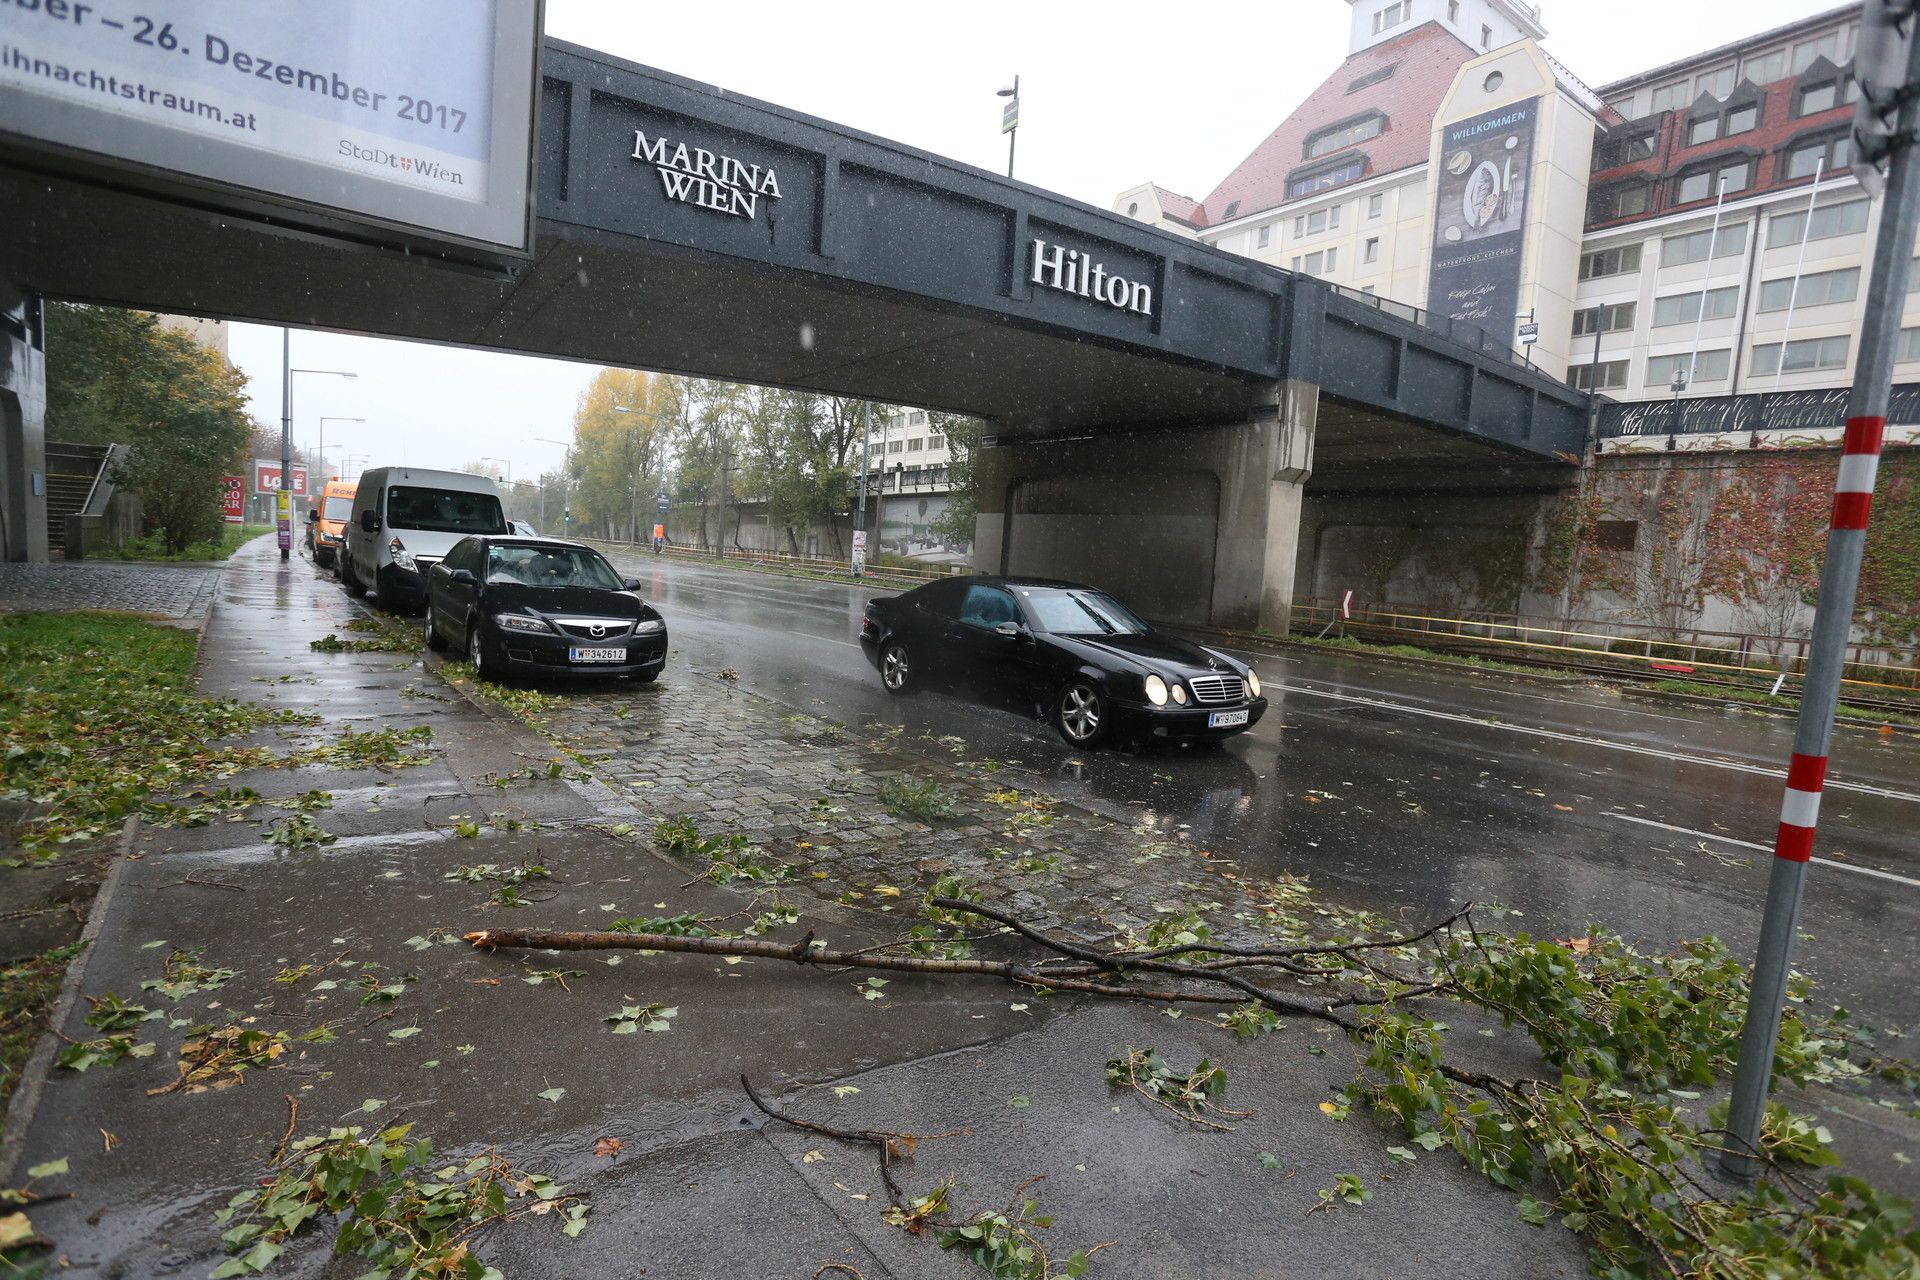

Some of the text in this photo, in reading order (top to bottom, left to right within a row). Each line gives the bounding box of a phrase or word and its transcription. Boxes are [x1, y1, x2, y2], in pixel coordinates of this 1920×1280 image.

[205, 34, 386, 111] Dezember
[396, 94, 467, 133] 2017
[1453, 110, 1527, 141] WILLKOMMEN
[414, 158, 463, 185] Wien
[631, 130, 782, 199] MARINA
[657, 167, 758, 219] WIEN
[1031, 238, 1152, 315] Hilton
[1484, 247, 1515, 258] KITCHEN
